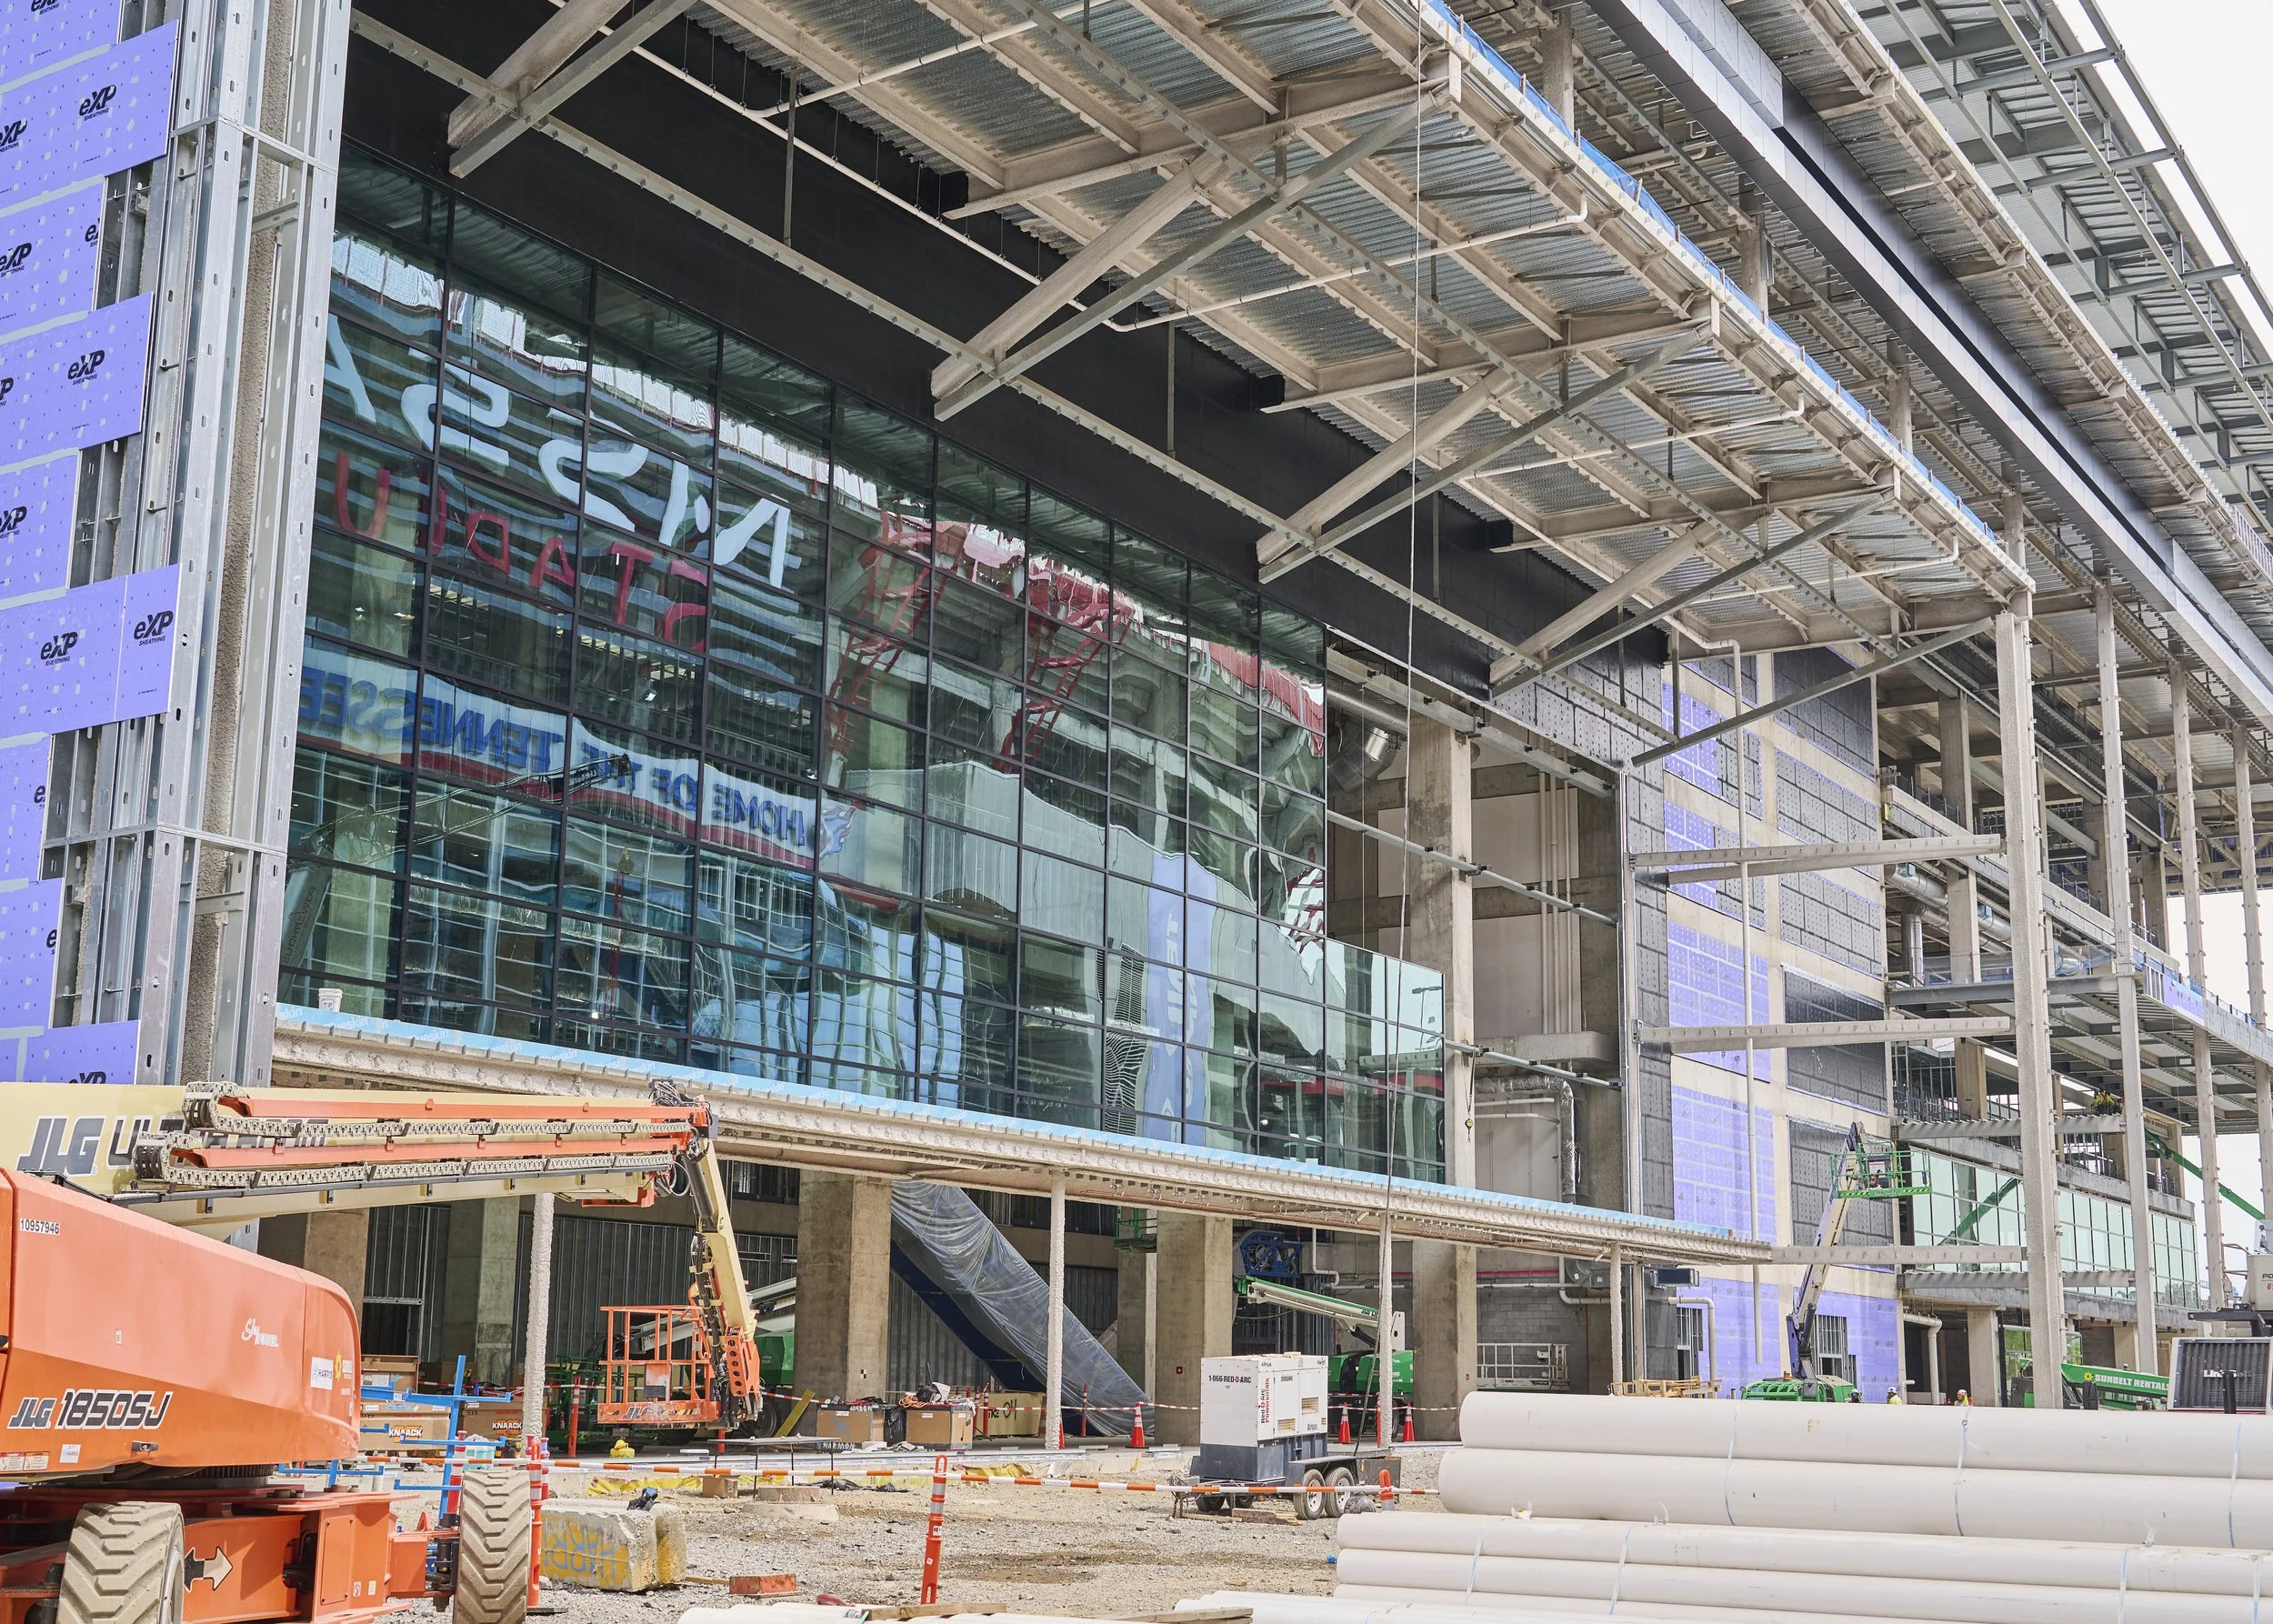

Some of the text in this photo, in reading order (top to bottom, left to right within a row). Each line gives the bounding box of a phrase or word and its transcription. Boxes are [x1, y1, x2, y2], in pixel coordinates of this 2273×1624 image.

[79, 85, 116, 116] eXP
[67, 349, 105, 379] eXP
[0, 506, 27, 532] XP
[134, 610, 174, 640] eXP
[40, 631, 78, 660] eXP
[139, 636, 165, 647] SHEATHING
[16, 1118, 105, 1175] JLG
[21, 1219, 60, 1234] 10957946
[2095, 1374, 2133, 1387] SUNBELT
[8, 1389, 172, 1429] JLG 1850SJ
[389, 1429, 423, 1437] KNAACK
